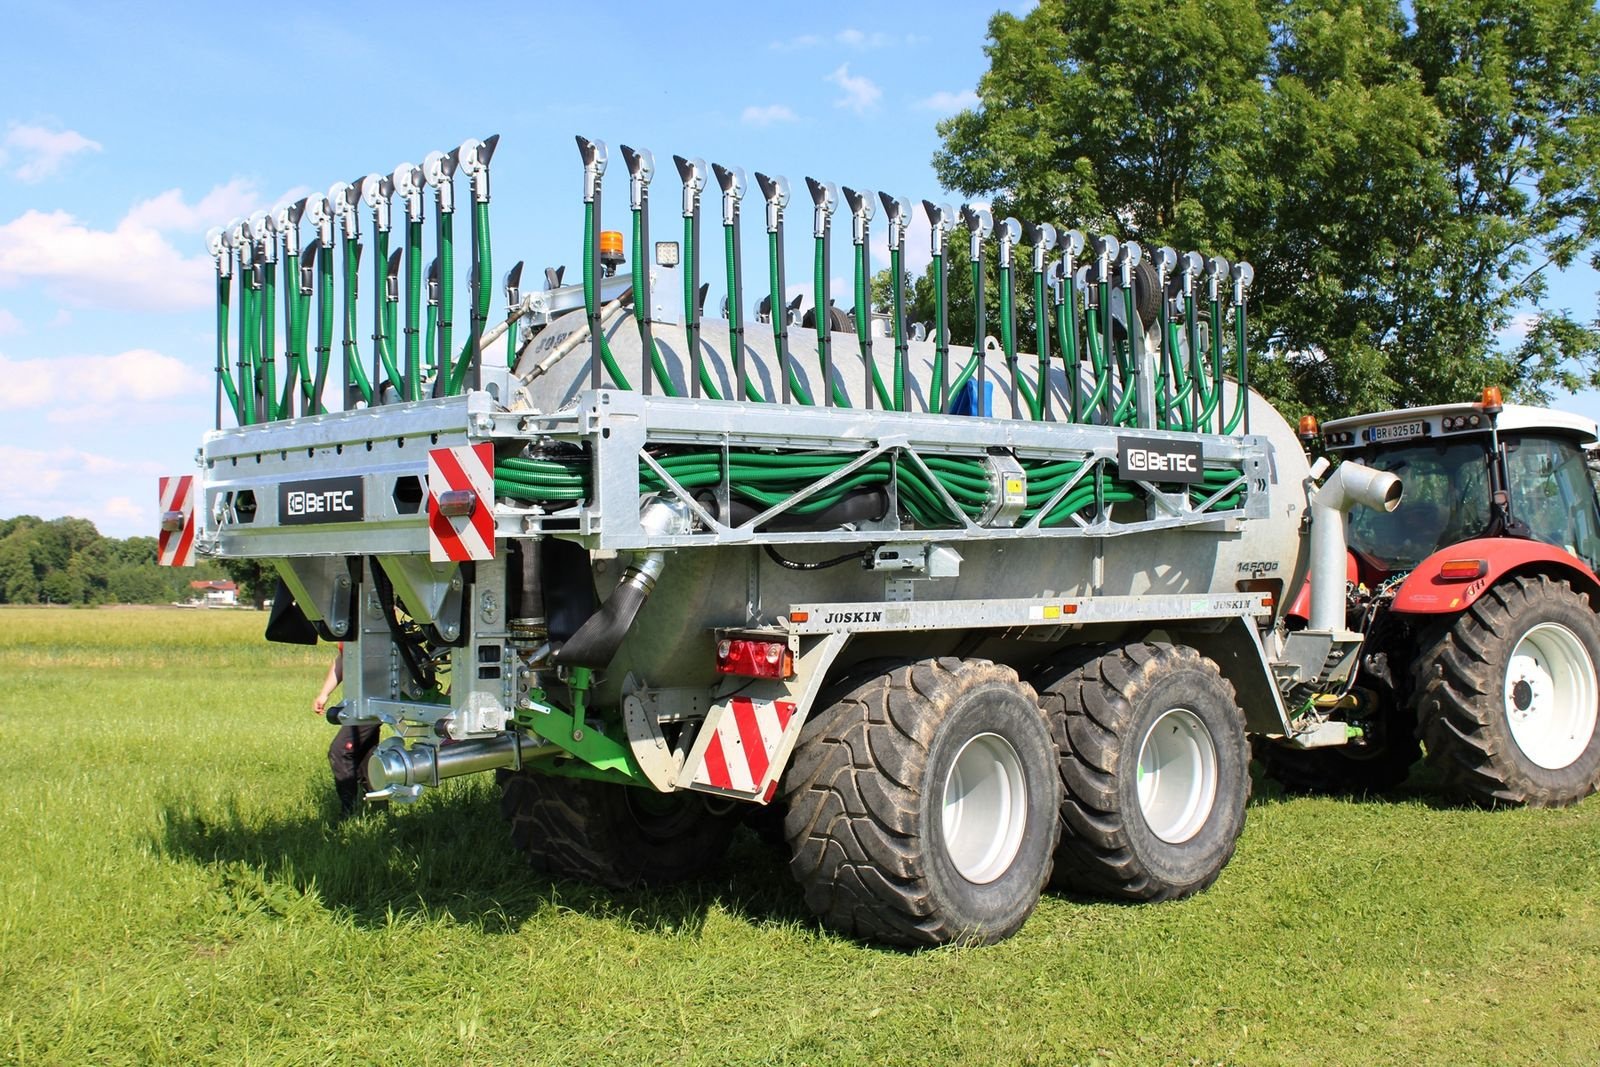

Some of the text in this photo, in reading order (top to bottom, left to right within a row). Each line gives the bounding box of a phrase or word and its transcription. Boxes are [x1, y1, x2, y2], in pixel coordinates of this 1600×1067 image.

[1377, 423, 1421, 439] BR 325 BZ
[1214, 600, 1251, 610] JOSKIN
[825, 611, 882, 623] JOSKIN
